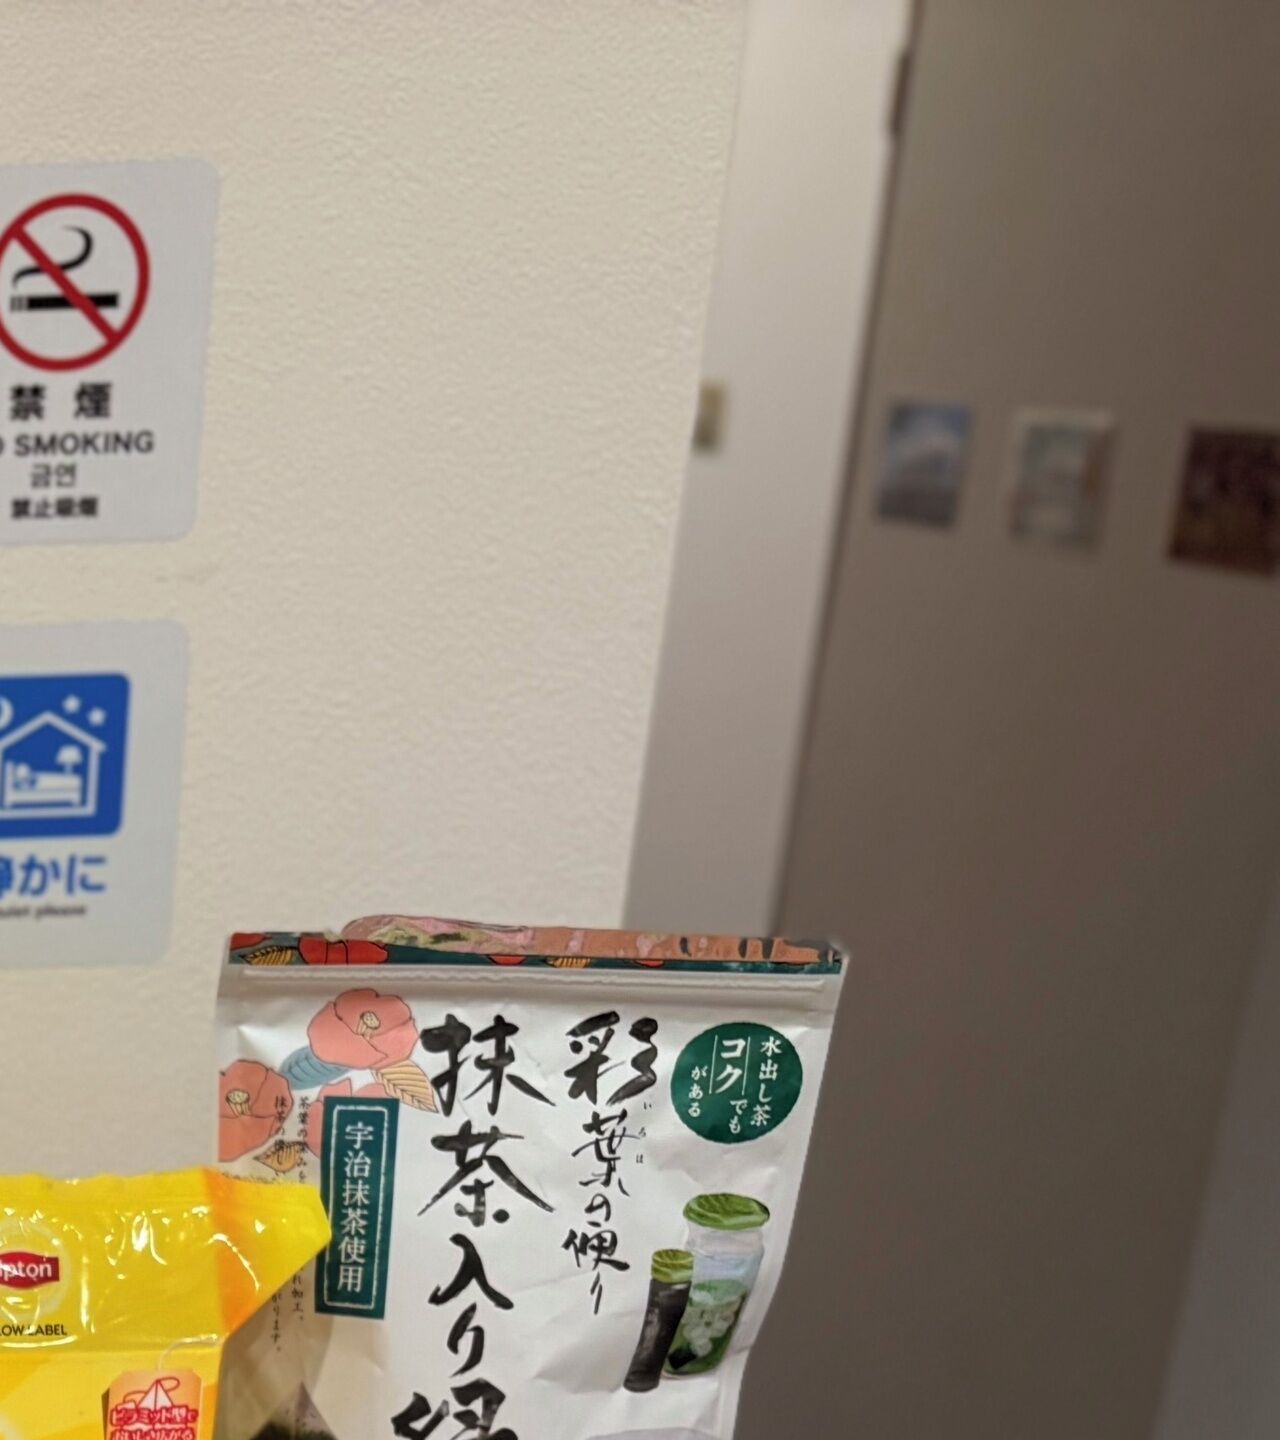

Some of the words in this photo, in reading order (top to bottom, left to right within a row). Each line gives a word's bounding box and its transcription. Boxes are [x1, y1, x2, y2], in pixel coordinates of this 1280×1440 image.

[8, 382, 112, 421] 禁煙
[14, 431, 155, 457] SMOKING
[30, 463, 77, 489] 금연
[35, 904, 87, 920] please
[688, 1066, 708, 1118] がある
[714, 1038, 748, 1134] コクでも
[750, 1036, 782, 1127] 水出し茶
[337, 1121, 374, 1293] 宇治抹茶使用
[28, 1323, 67, 1337] LABEL
